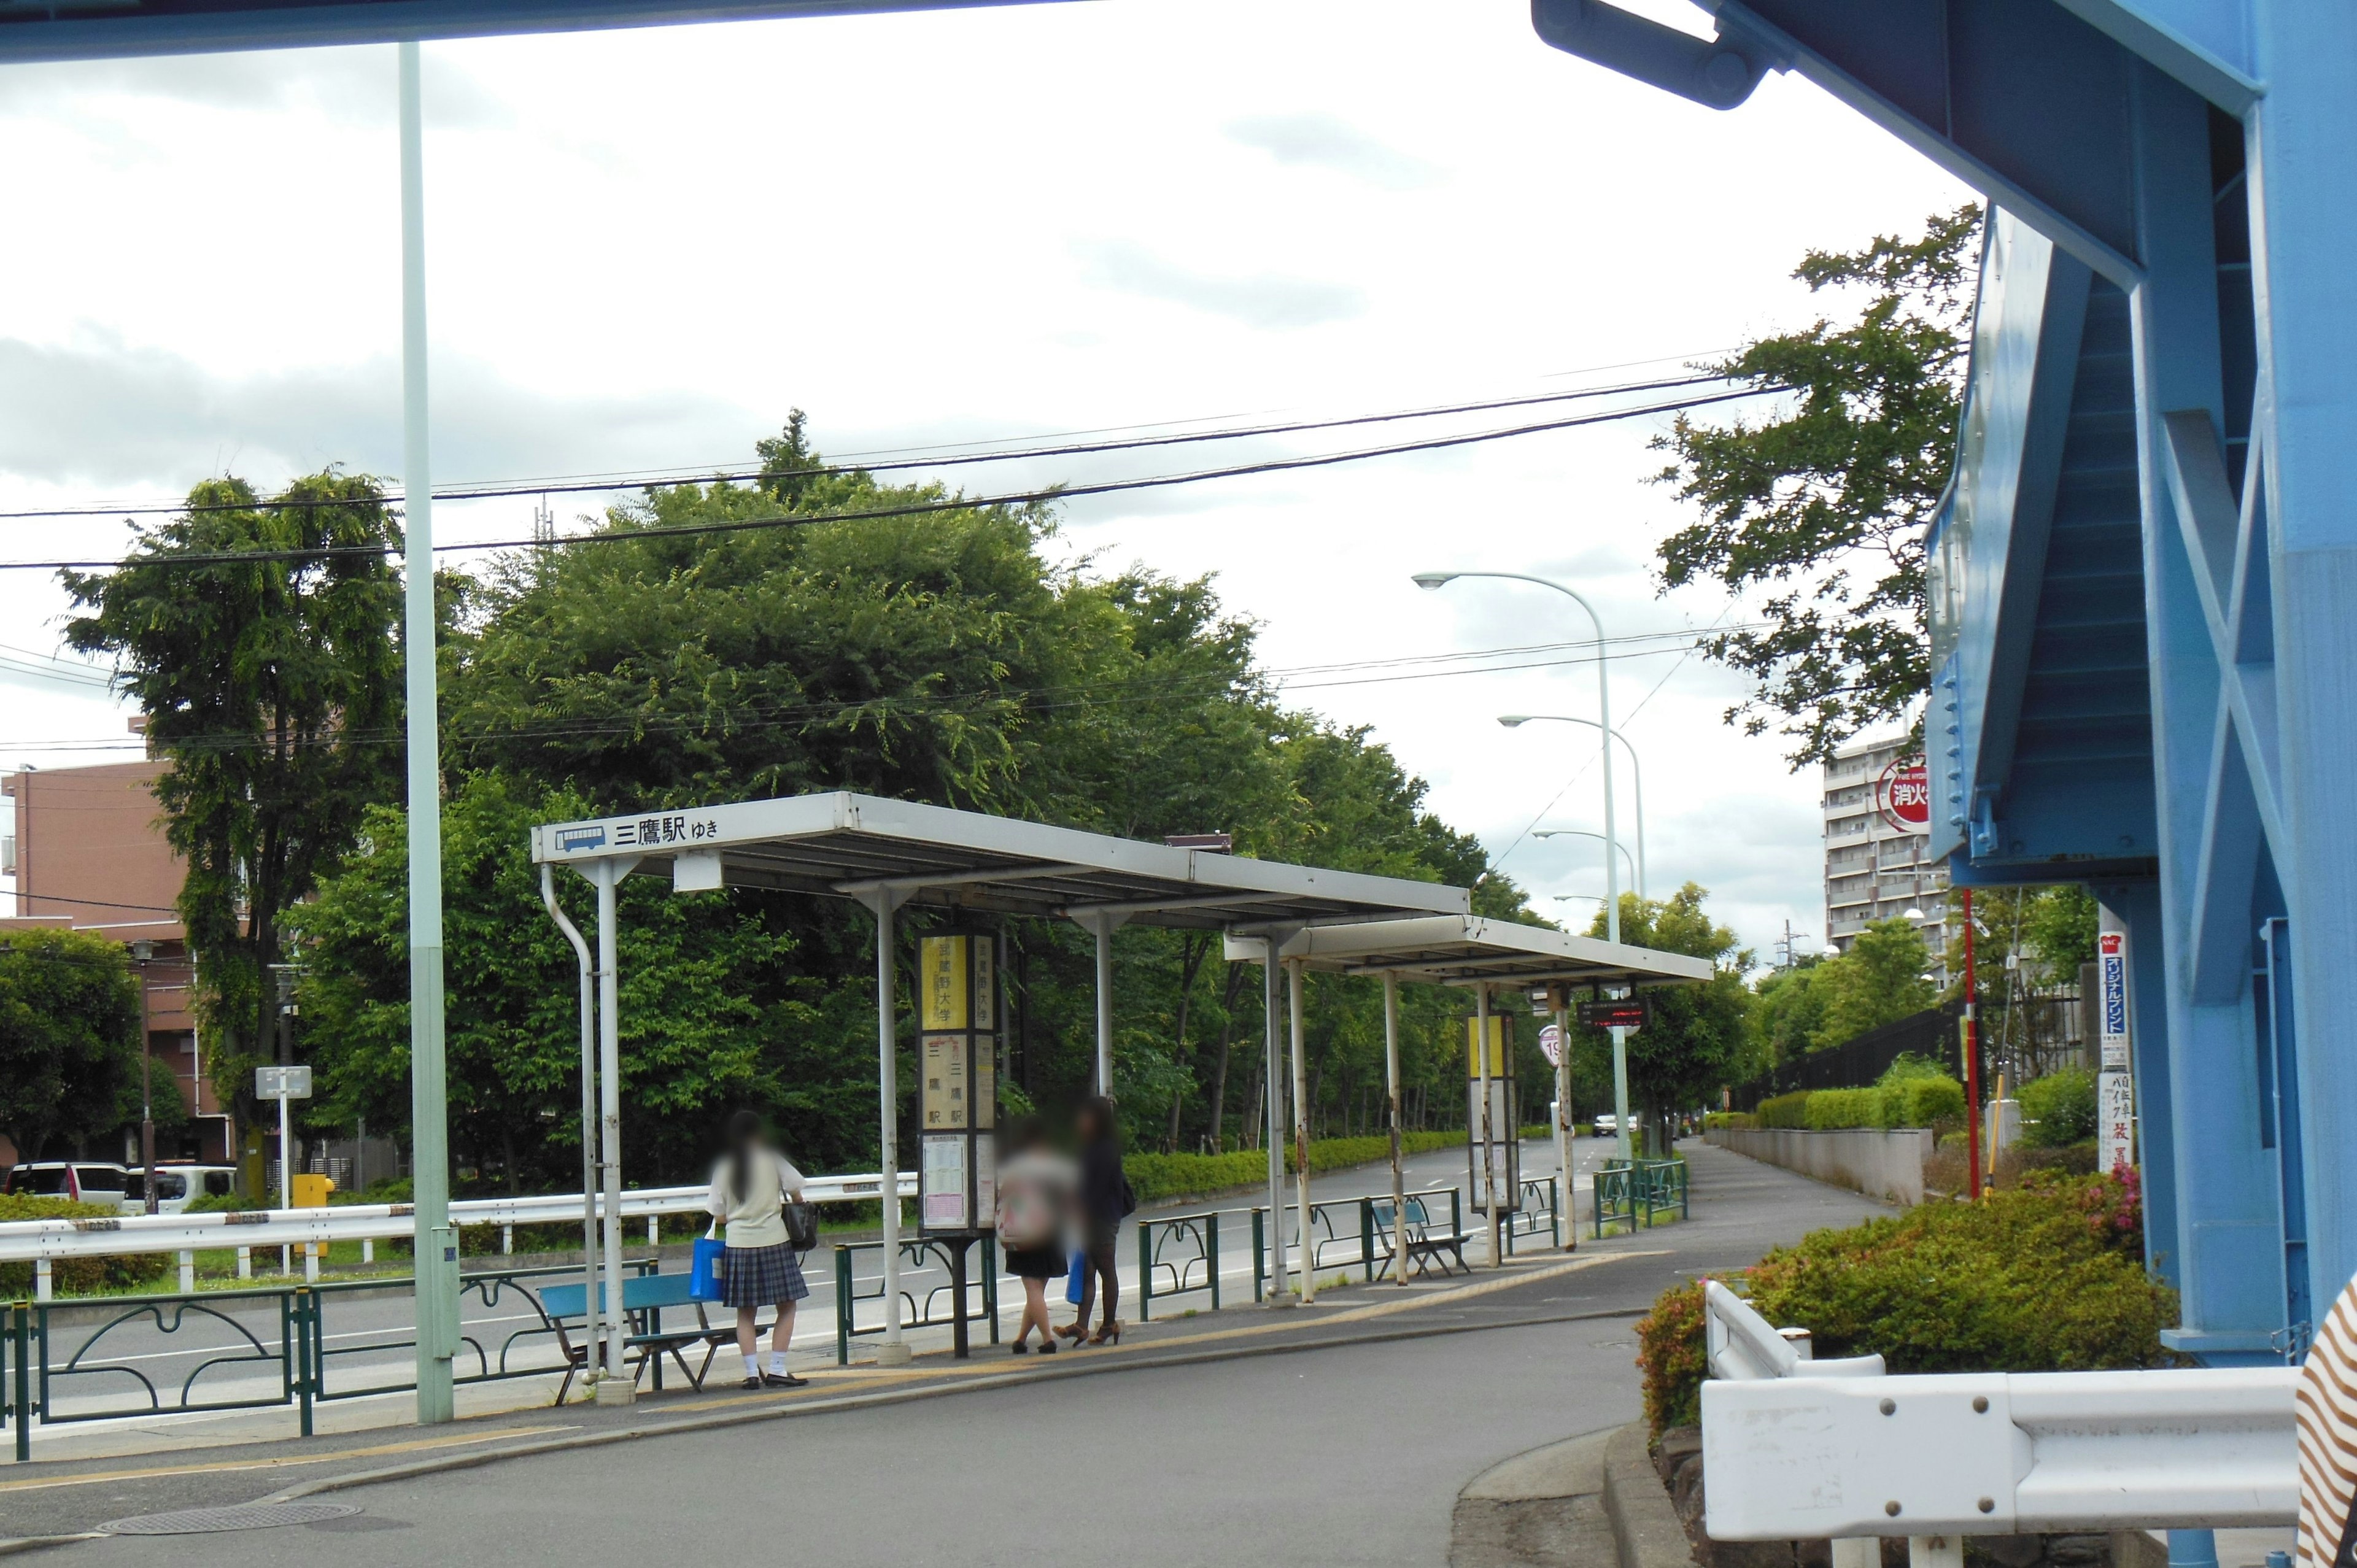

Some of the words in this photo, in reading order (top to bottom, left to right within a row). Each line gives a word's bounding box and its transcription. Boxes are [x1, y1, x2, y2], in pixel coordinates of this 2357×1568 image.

[1894, 783, 1929, 806] 消火
[939, 943, 951, 1021] 武蔵野大学
[2107, 958, 2122, 1033] オリジナルプリント
[928, 1045, 941, 1124] 三鷹駅
[950, 1063, 962, 1123] 三鷹駅
[2112, 1077, 2121, 1119] バイク
[2121, 1076, 2131, 1119] 自転車
